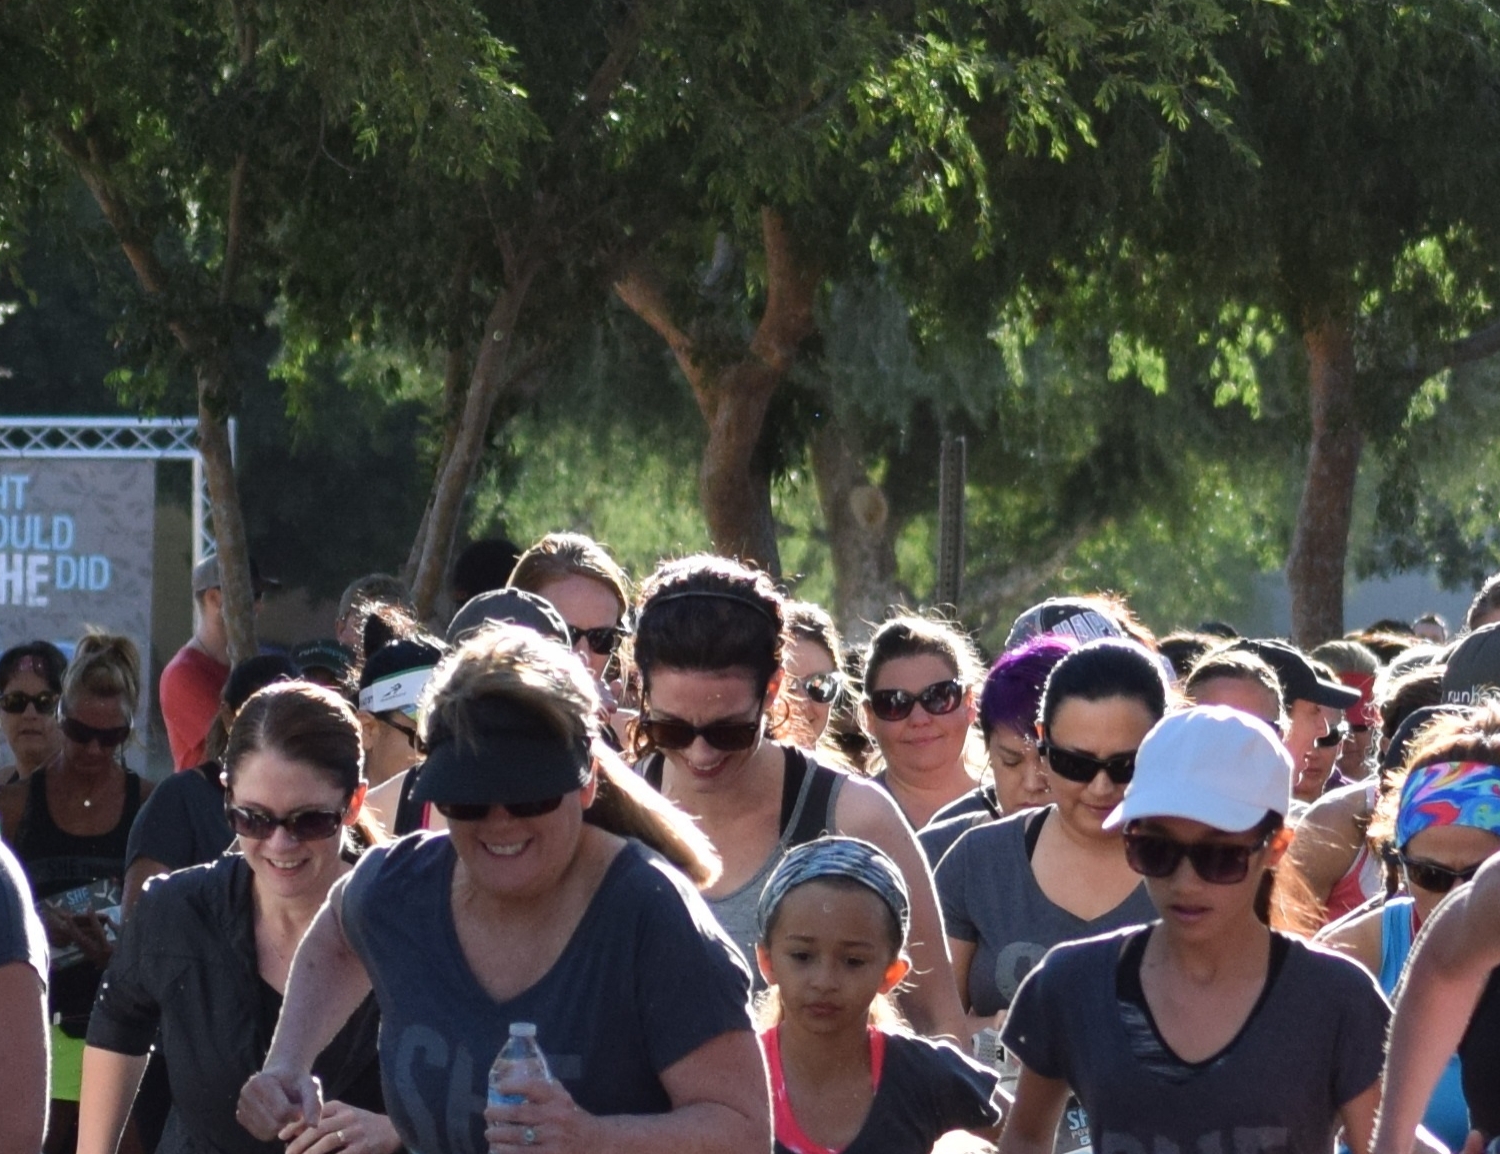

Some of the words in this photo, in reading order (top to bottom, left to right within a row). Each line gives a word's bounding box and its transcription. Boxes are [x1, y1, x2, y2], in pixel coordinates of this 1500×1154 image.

[55, 554, 111, 590] DID
[66, 888, 89, 905] SHE
[1067, 1107, 1088, 1130] SH
